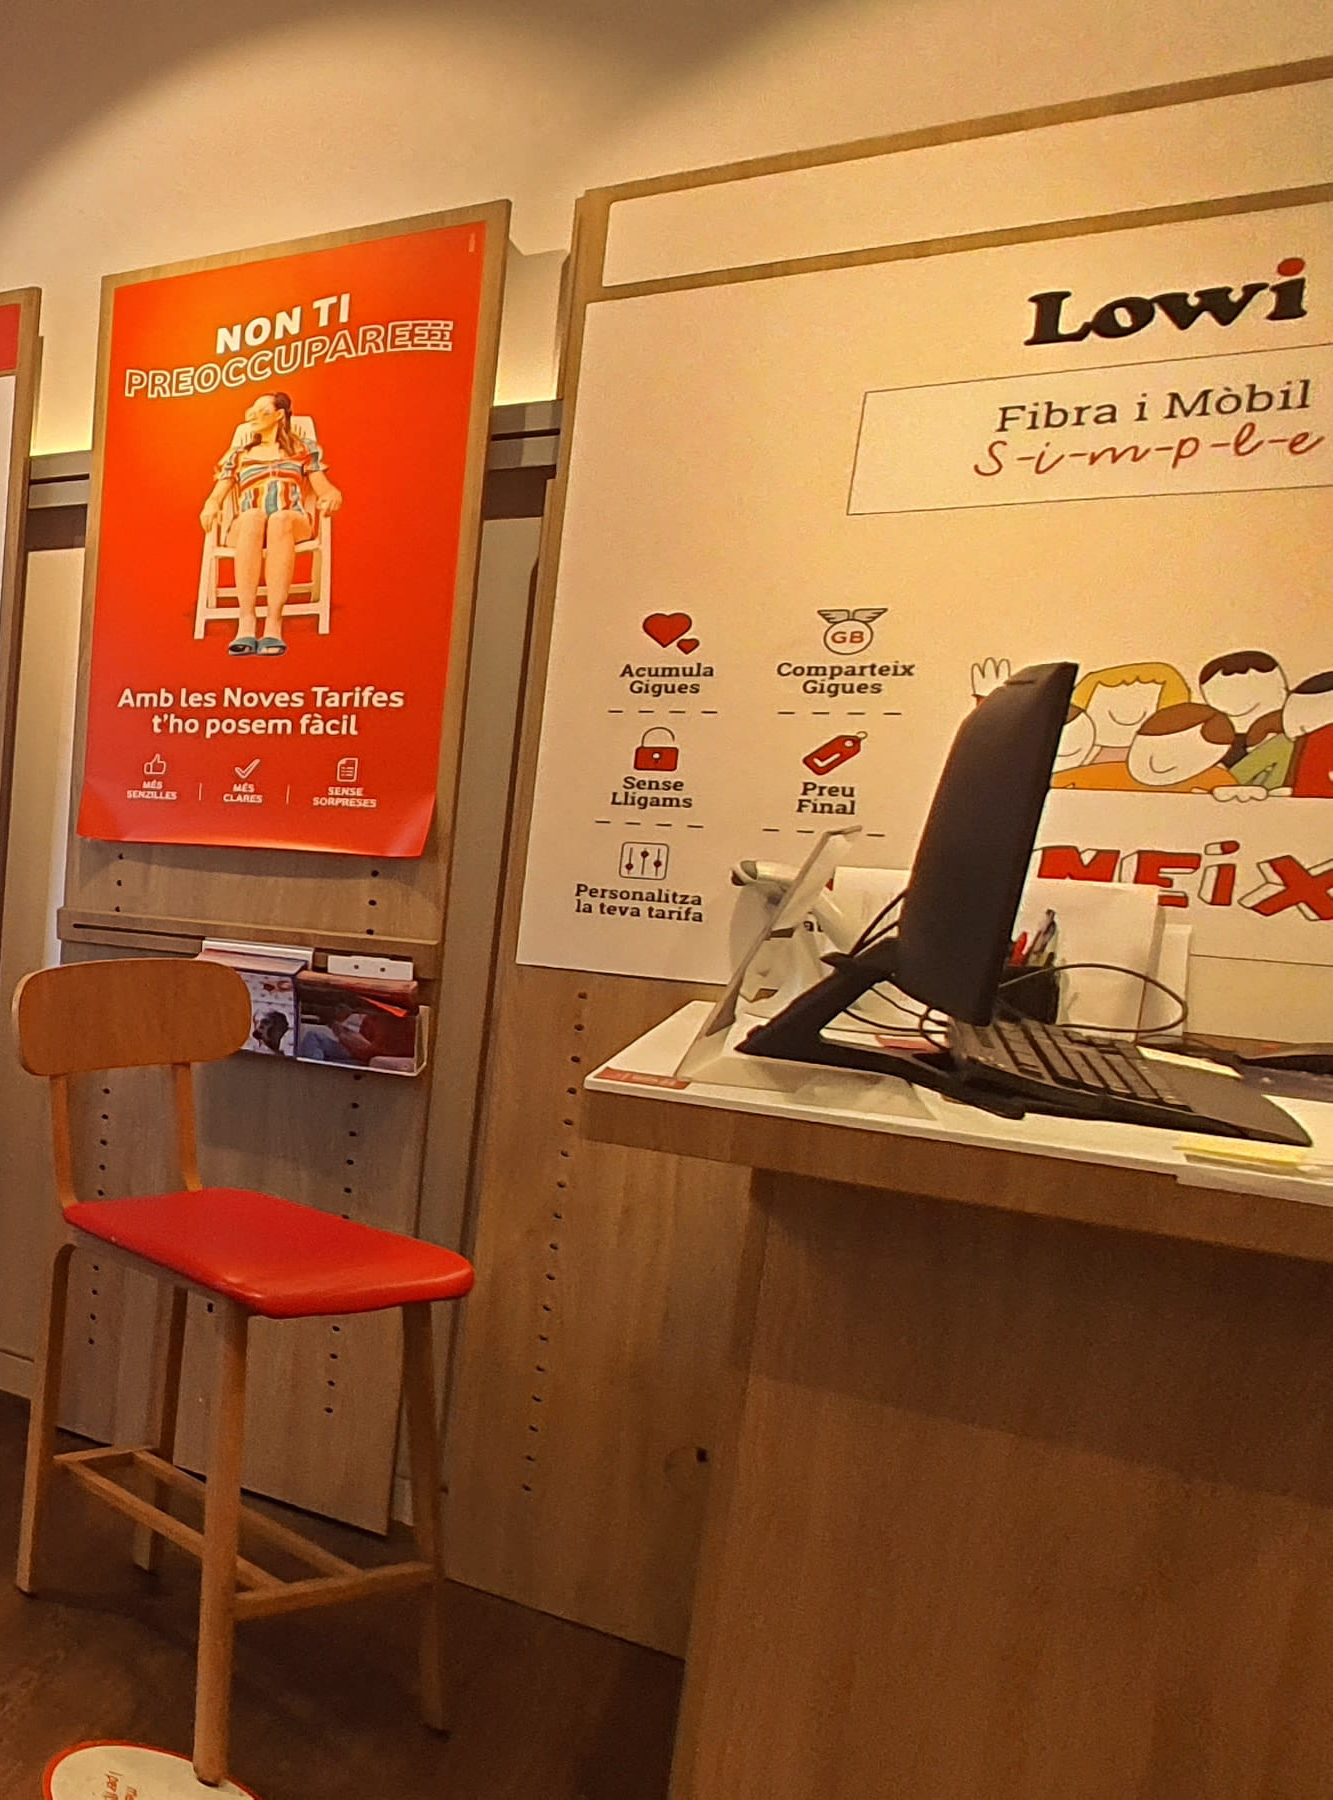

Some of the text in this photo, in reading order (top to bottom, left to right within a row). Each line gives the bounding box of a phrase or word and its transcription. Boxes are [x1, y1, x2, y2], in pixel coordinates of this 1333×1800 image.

[1023, 256, 1308, 347] Lowi
[215, 293, 351, 355] NON TI
[994, 378, 1311, 433] Fibra i Mòbil
[831, 631, 865, 645] GB
[619, 662, 715, 678] Acumula
[776, 661, 916, 680] Comparteix
[117, 685, 405, 708] Amb les Noves Tarifes
[629, 679, 701, 697] Gigues
[802, 679, 883, 698] Gigues
[205, 717, 293, 738] posem
[300, 713, 358, 736] fàcil
[142, 780, 163, 790] MÉS
[233, 782, 254, 793] MÉS
[328, 786, 363, 797] SENSE
[622, 775, 684, 792] Sense
[800, 781, 856, 798] Preu
[126, 790, 178, 801] SENZILLES
[223, 793, 263, 804] CLARES
[313, 797, 377, 808] SORPRESES
[610, 791, 694, 810] Lligams
[795, 799, 856, 816] Final
[575, 883, 702, 906] Personalitza
[575, 899, 703, 922] la teva tarifa
